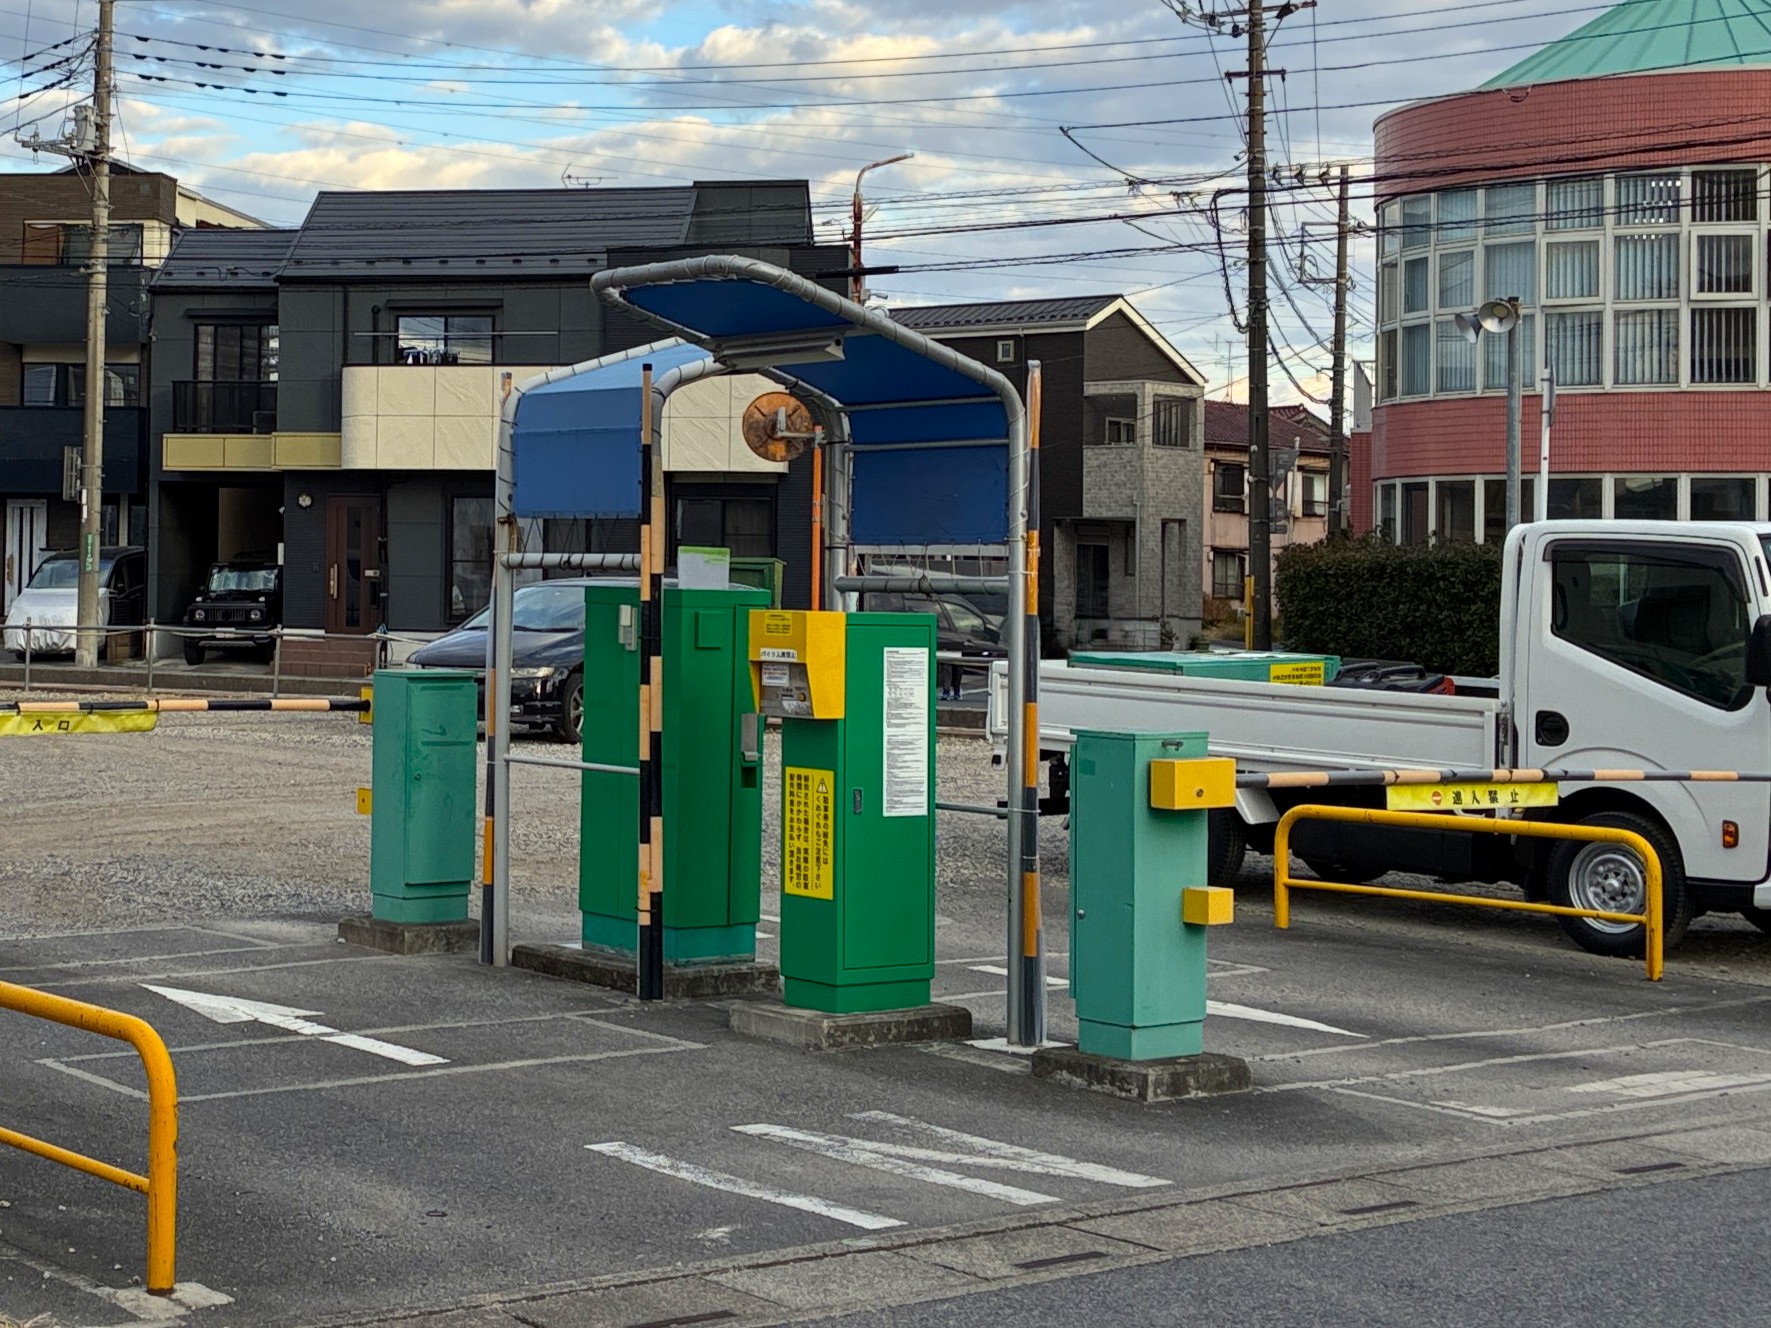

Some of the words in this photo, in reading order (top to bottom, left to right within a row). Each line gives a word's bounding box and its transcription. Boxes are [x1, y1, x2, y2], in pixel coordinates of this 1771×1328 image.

[32, 719, 70, 731] 入口
[1452, 788, 1519, 805] 進入禁止
